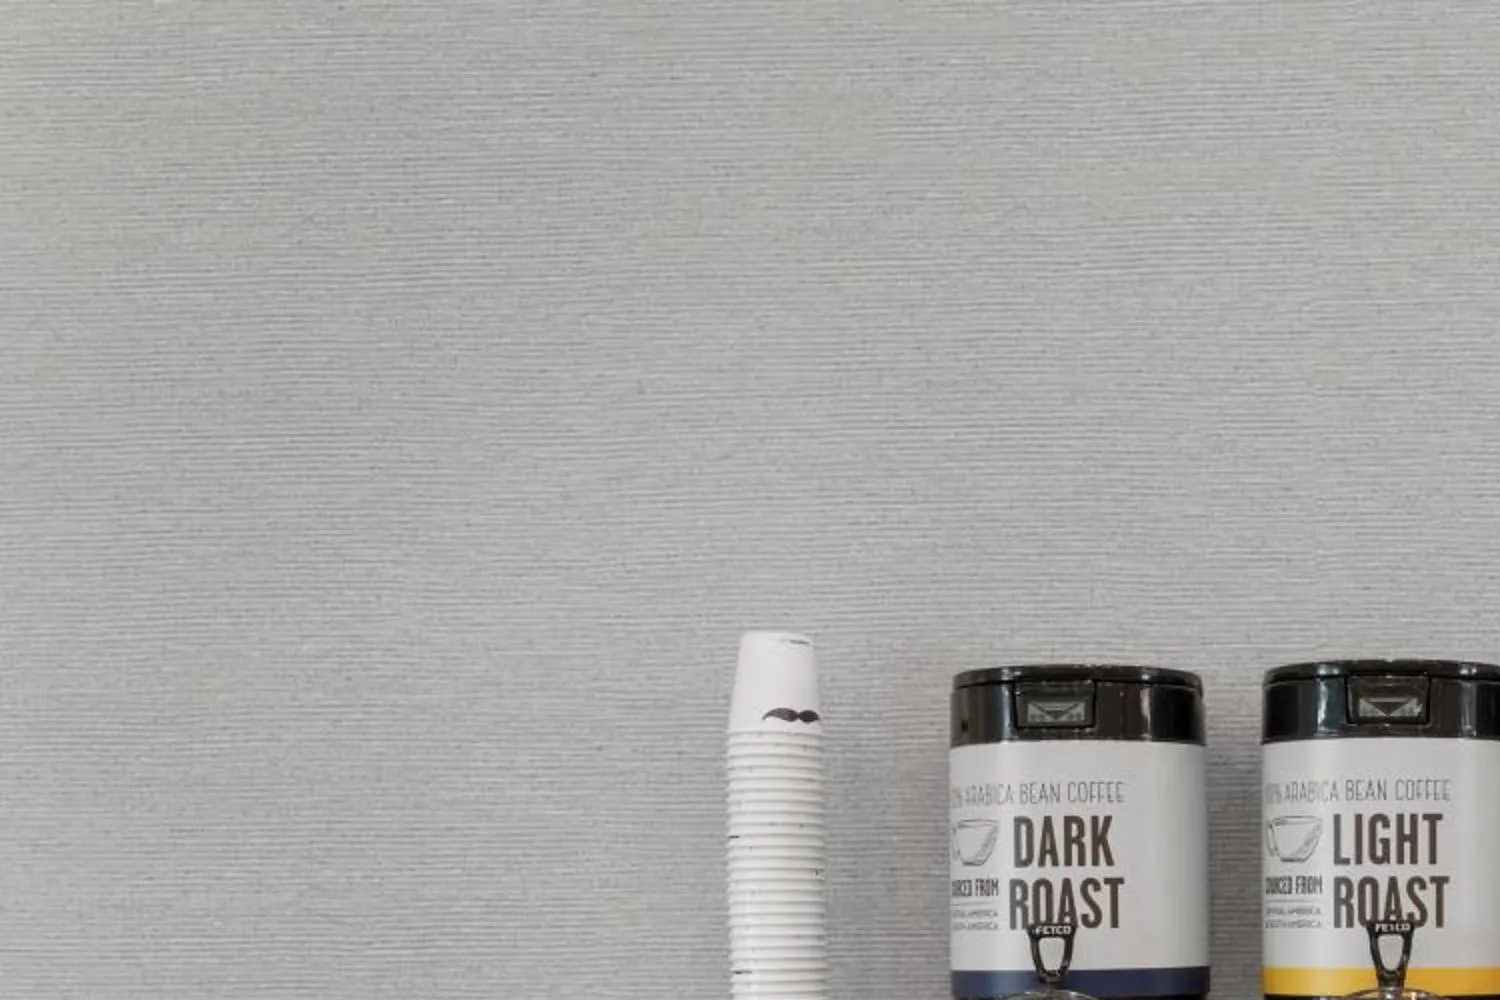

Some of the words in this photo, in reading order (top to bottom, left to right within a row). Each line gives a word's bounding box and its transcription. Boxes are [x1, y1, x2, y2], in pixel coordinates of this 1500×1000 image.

[1020, 781, 1061, 804] BEAN
[1067, 780, 1124, 804] COFFEE
[1345, 778, 1387, 801] BEAN
[1395, 778, 1451, 801] COFFEE
[1013, 815, 1115, 868] DARK
[1332, 813, 1443, 866] LIGHT
[1009, 877, 1124, 930] ROAST
[1333, 876, 1450, 929] ROAST
